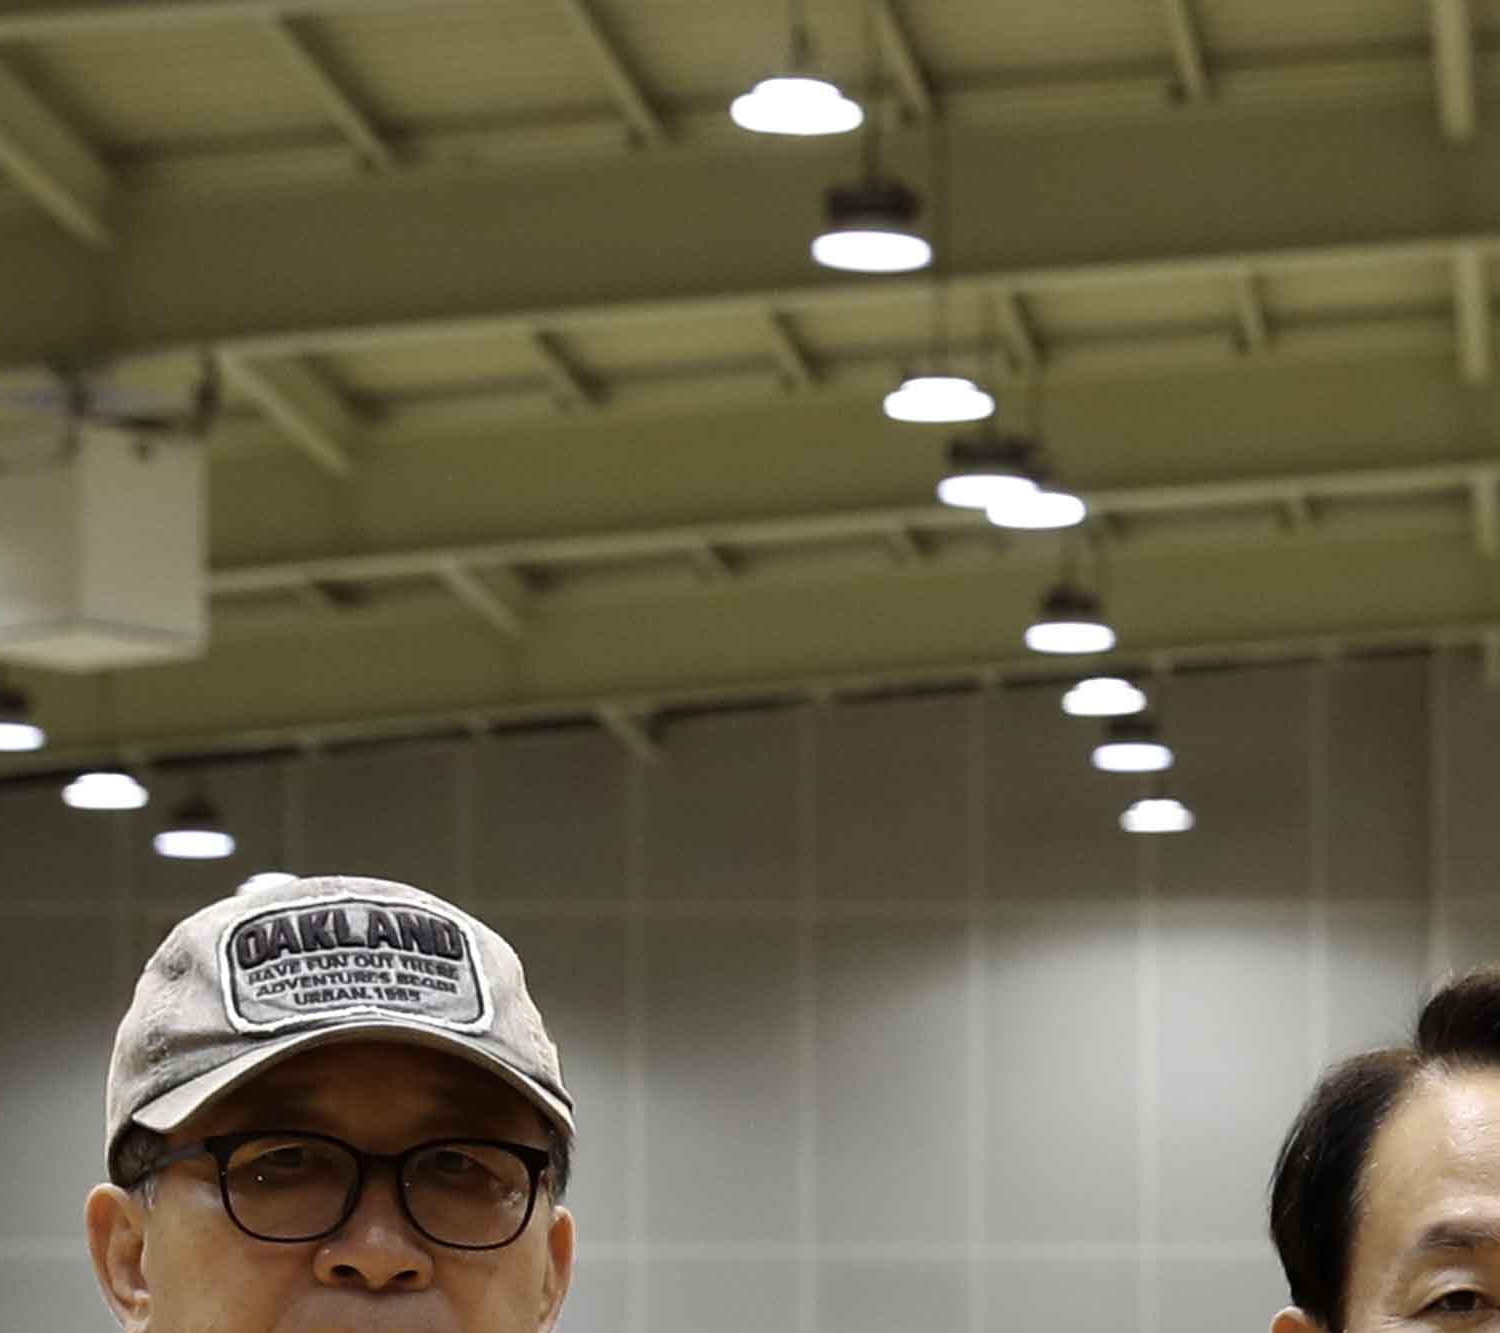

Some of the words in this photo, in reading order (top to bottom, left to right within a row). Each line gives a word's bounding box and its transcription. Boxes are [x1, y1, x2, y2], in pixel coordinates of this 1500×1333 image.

[237, 908, 464, 970] OAKLAND
[248, 957, 302, 985] HAVE
[307, 952, 348, 971] FUN
[354, 951, 394, 969] OUT
[256, 971, 390, 998] ADVENTURES
